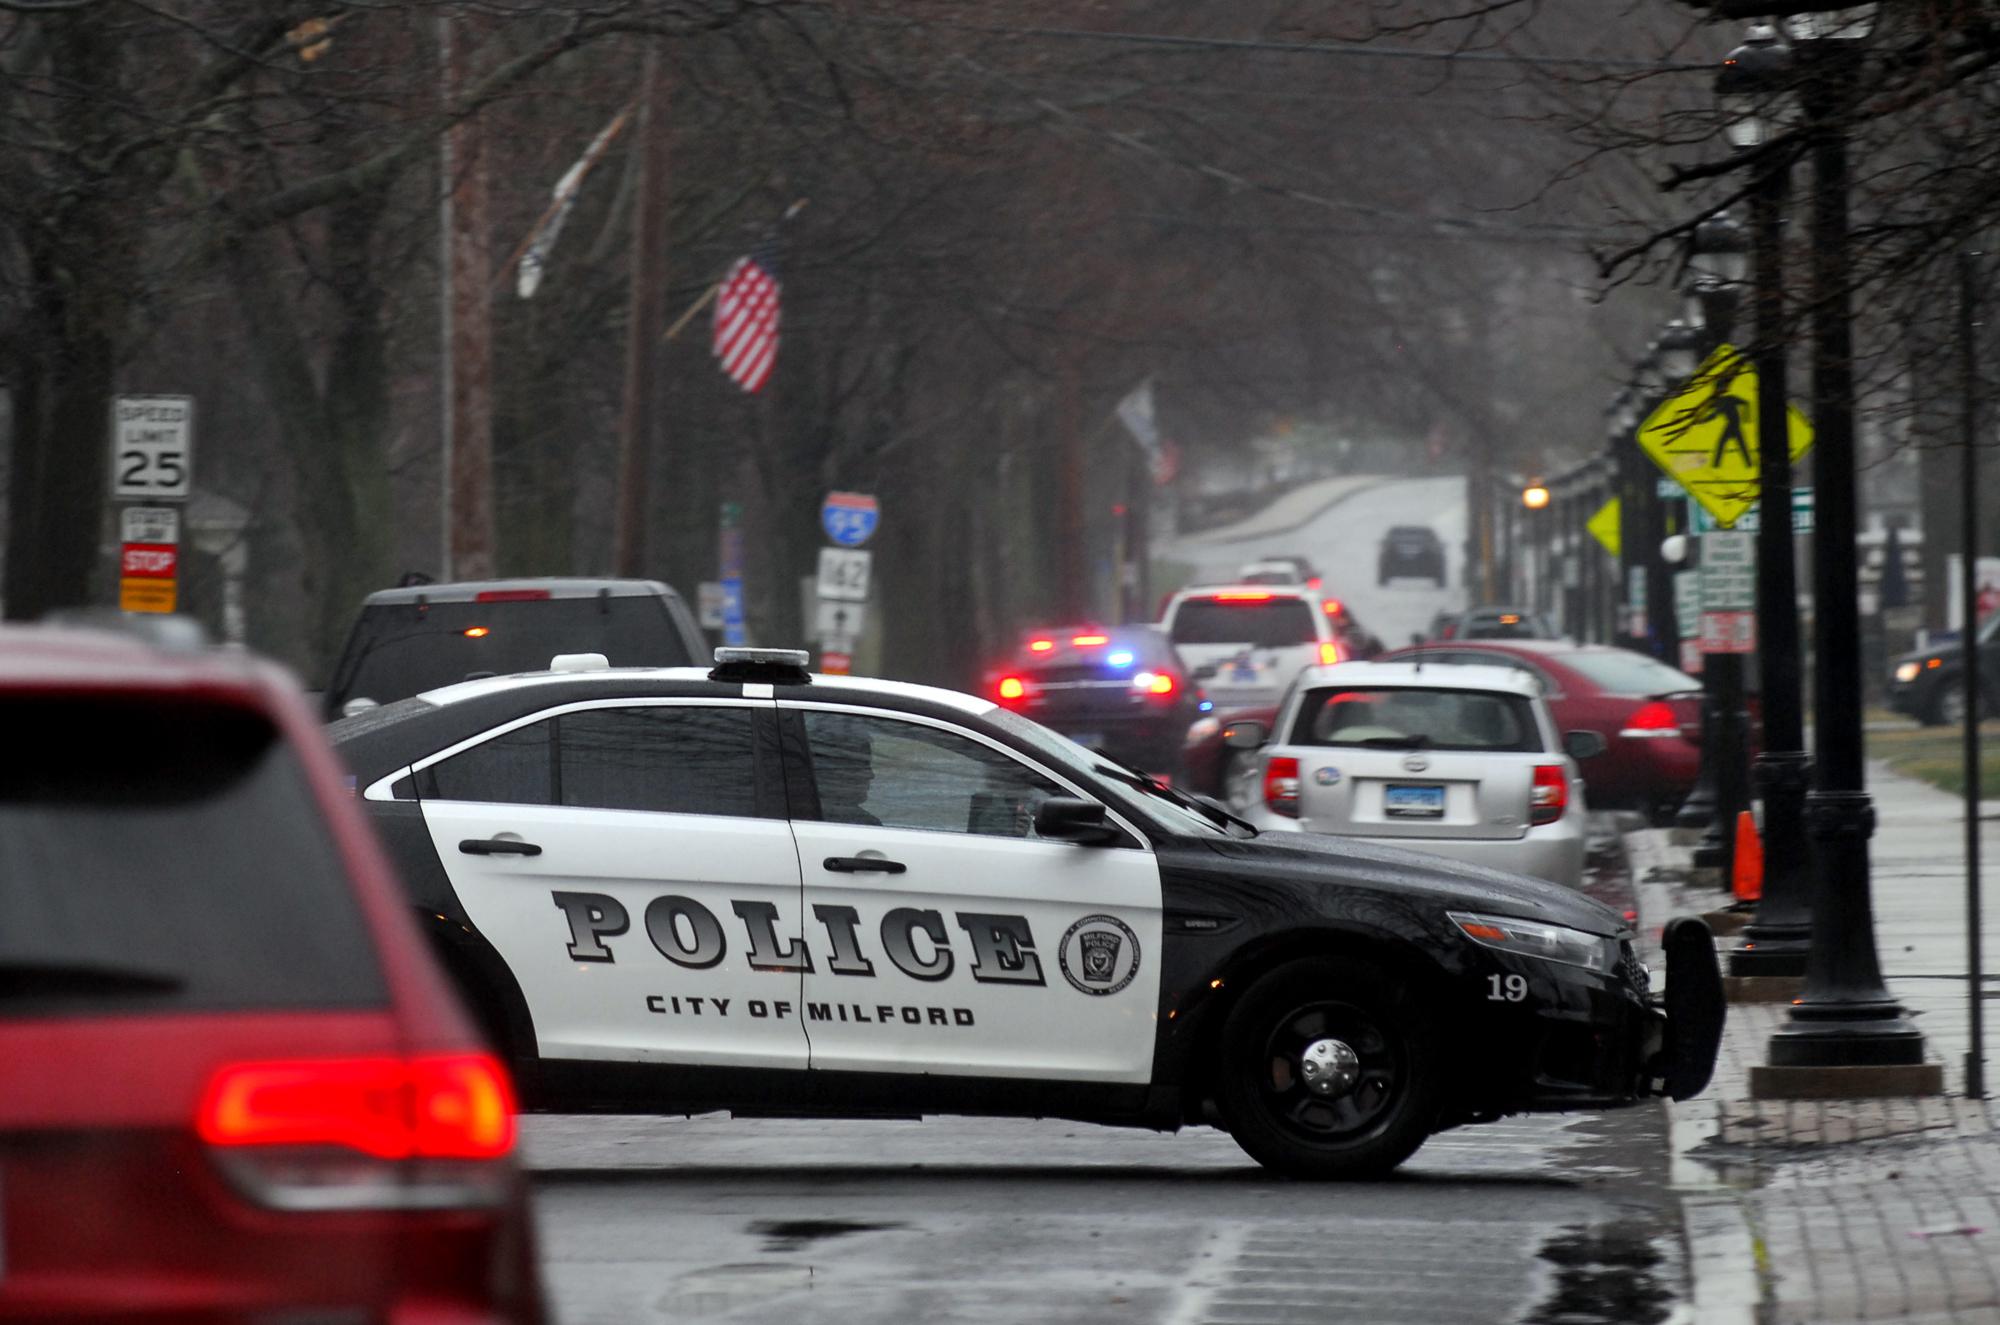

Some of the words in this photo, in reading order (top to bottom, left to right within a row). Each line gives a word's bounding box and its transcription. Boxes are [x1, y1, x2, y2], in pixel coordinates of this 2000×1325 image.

[119, 406, 183, 422] SPEED
[126, 429, 178, 444] LIMIT
[120, 450, 185, 487] 25
[831, 509, 868, 540] 95
[124, 549, 175, 572] STOP
[552, 889, 1047, 987] POLICE
[1083, 933, 1119, 945] MILFORD
[1085, 940, 1115, 949] POLICE
[1487, 973, 1528, 1002] 19
[646, 995, 731, 1017] CITY
[748, 1000, 792, 1019] OF
[807, 1002, 975, 1026] MILFORD
